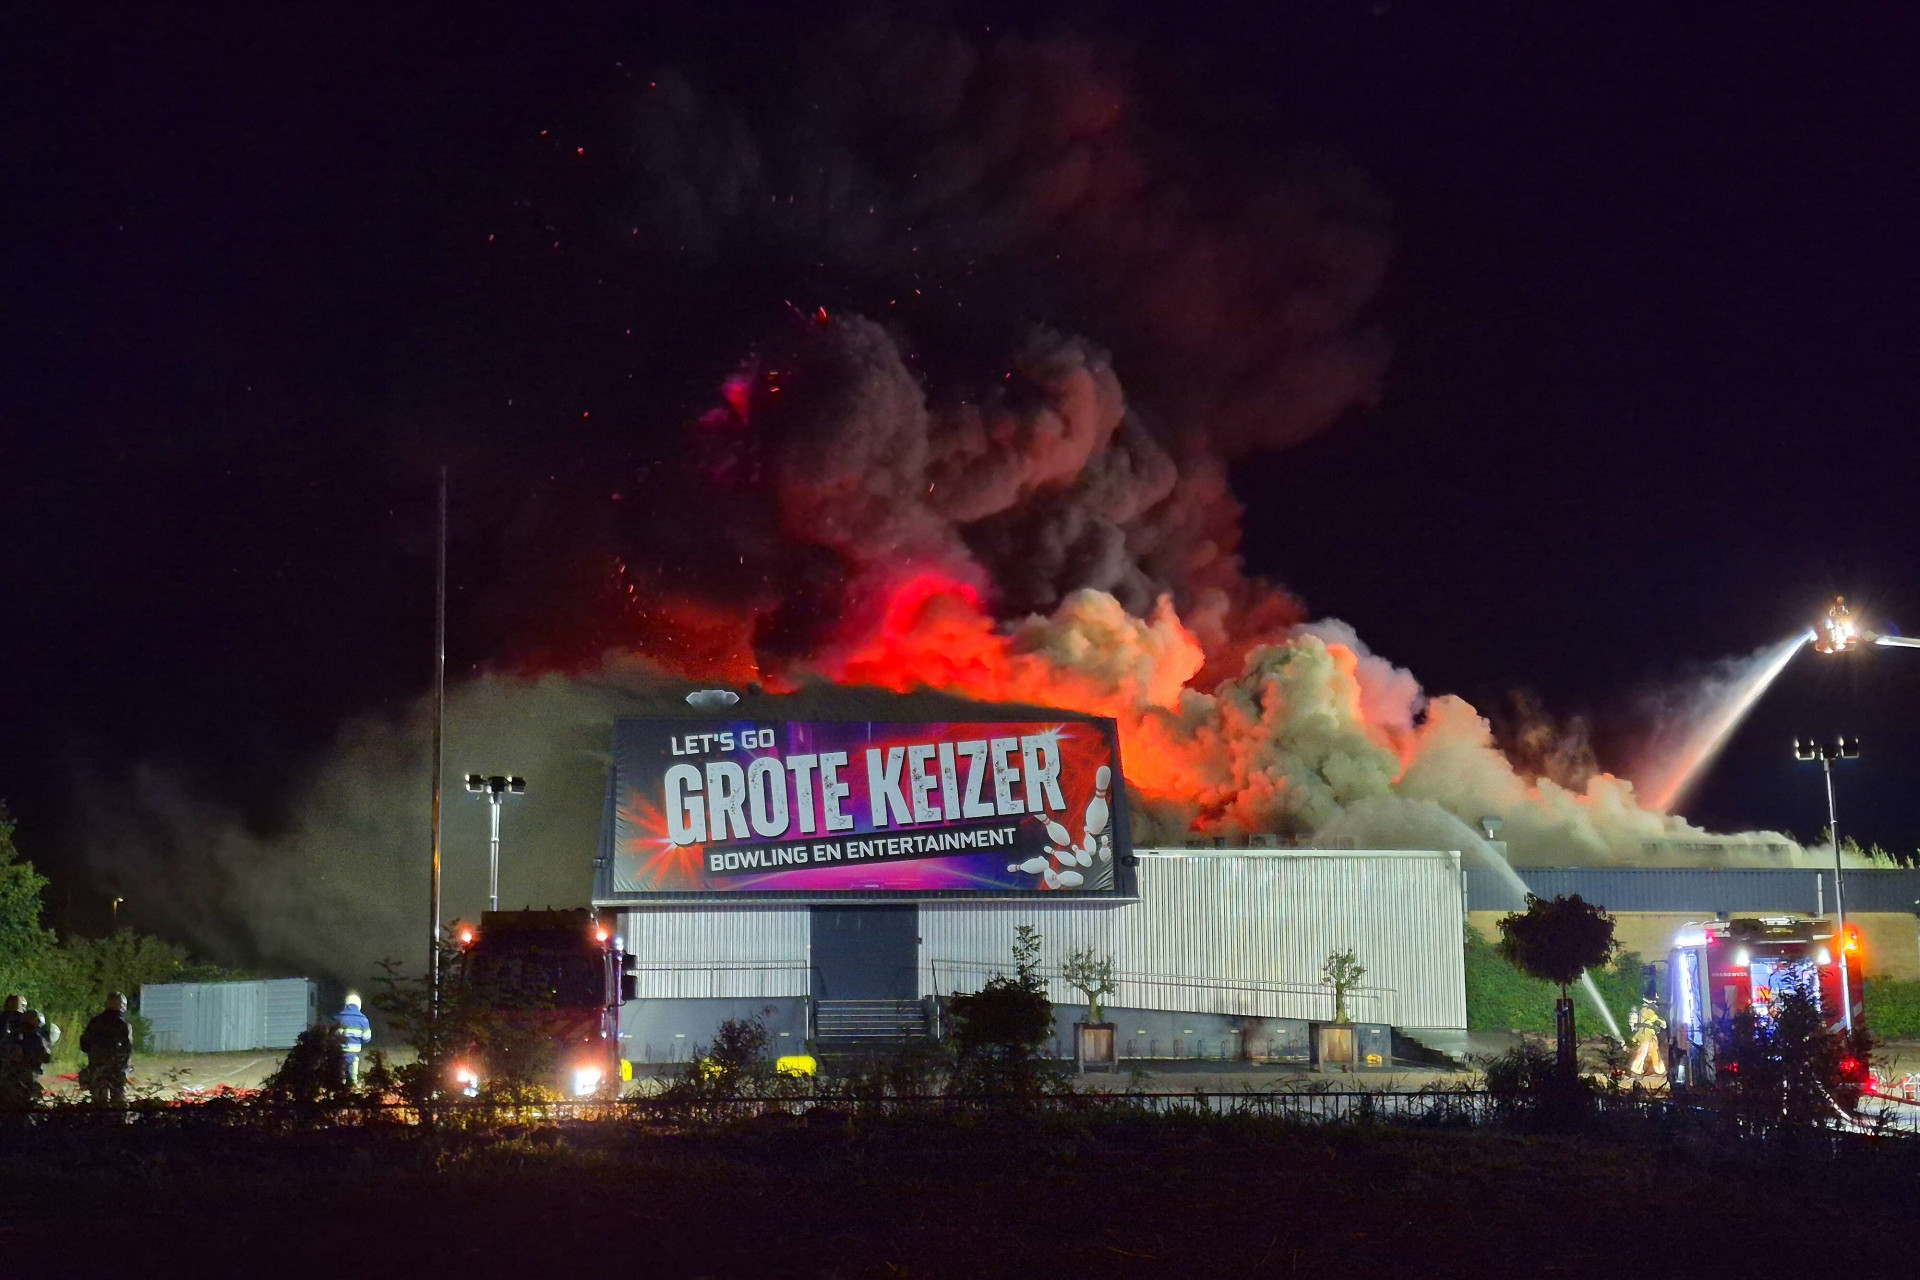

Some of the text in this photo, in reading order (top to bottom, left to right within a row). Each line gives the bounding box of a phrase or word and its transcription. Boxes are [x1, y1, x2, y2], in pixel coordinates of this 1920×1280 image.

[671, 729, 775, 756] LET'S GO
[664, 734, 1067, 845] GROTE KEIZER
[710, 828, 1016, 872] BOWLING EN ENTERTAINMENT
